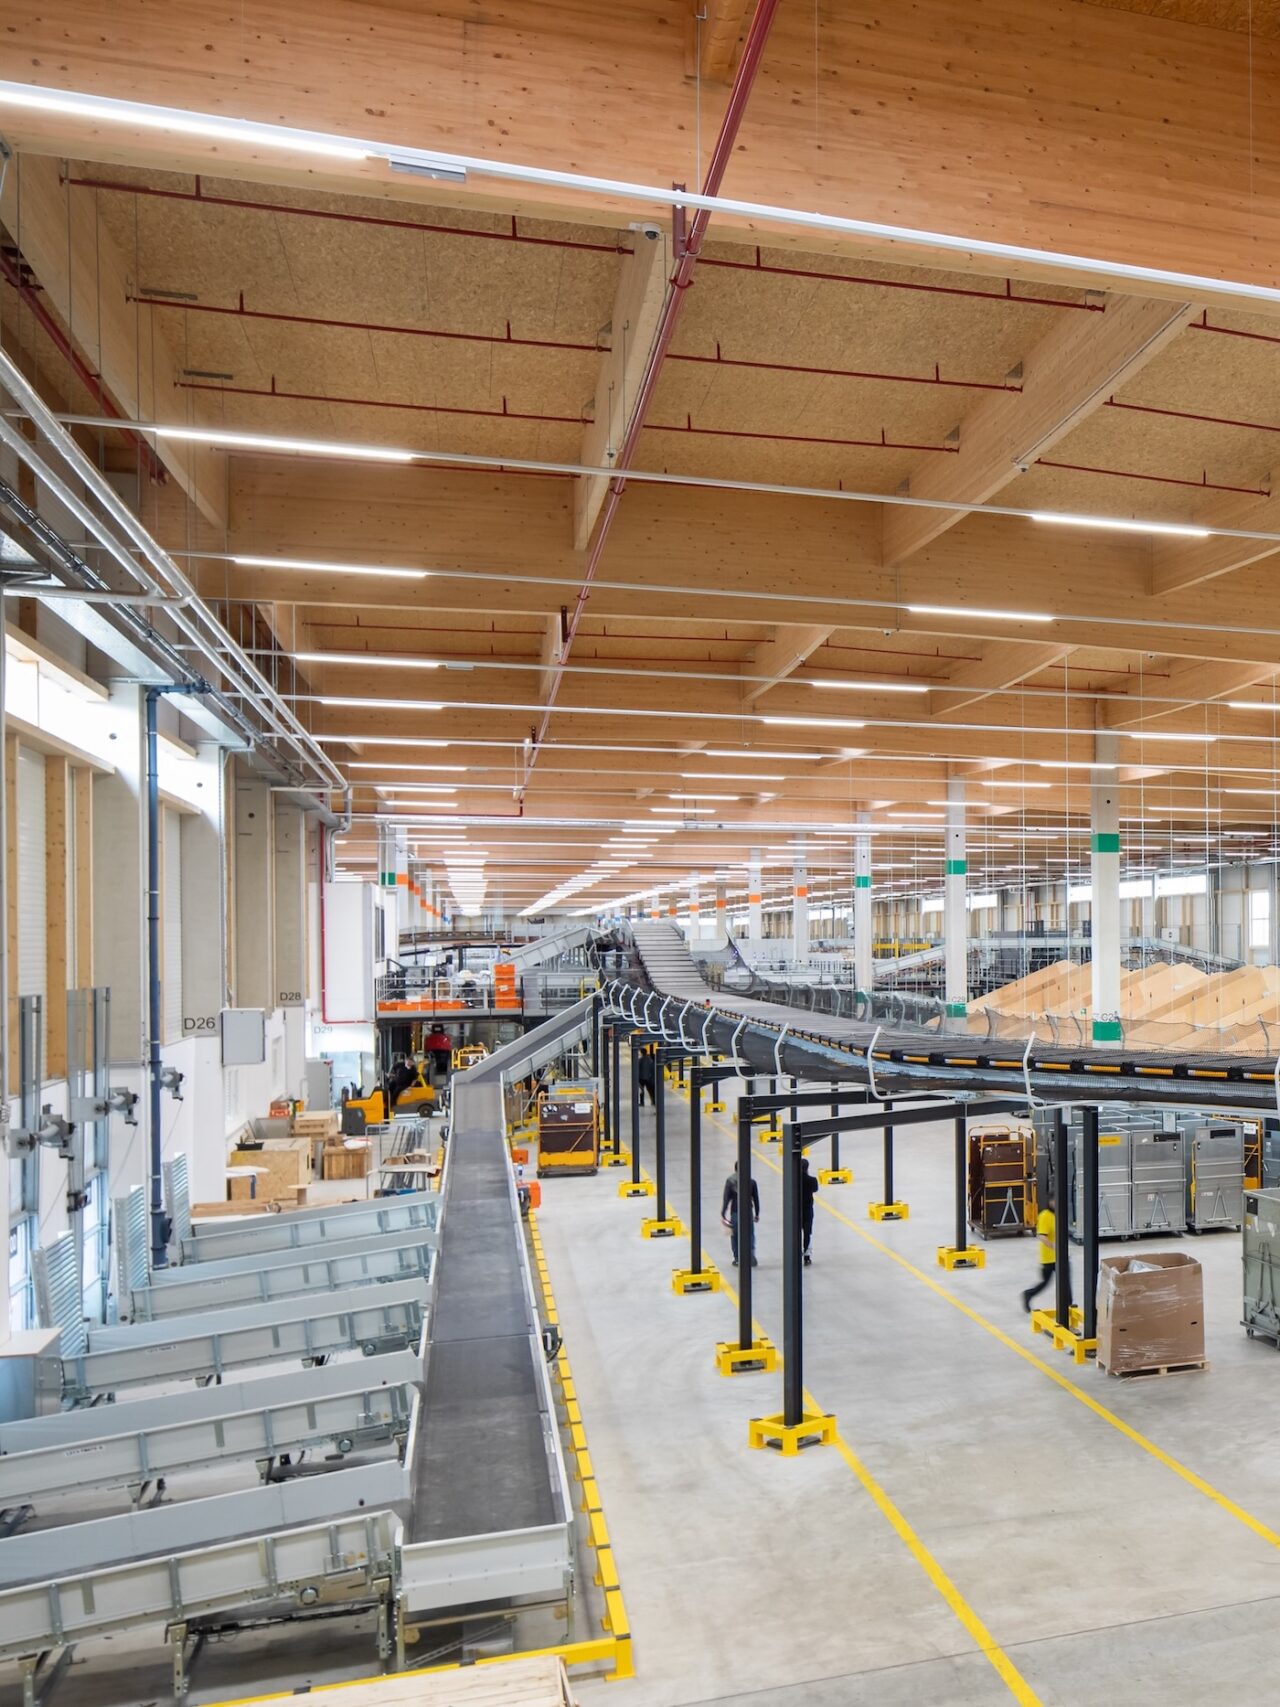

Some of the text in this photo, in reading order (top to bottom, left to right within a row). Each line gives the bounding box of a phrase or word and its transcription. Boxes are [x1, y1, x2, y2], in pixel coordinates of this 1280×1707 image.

[279, 991, 302, 1002] D28
[183, 1016, 216, 1031] D26
[313, 1025, 333, 1034] D29
